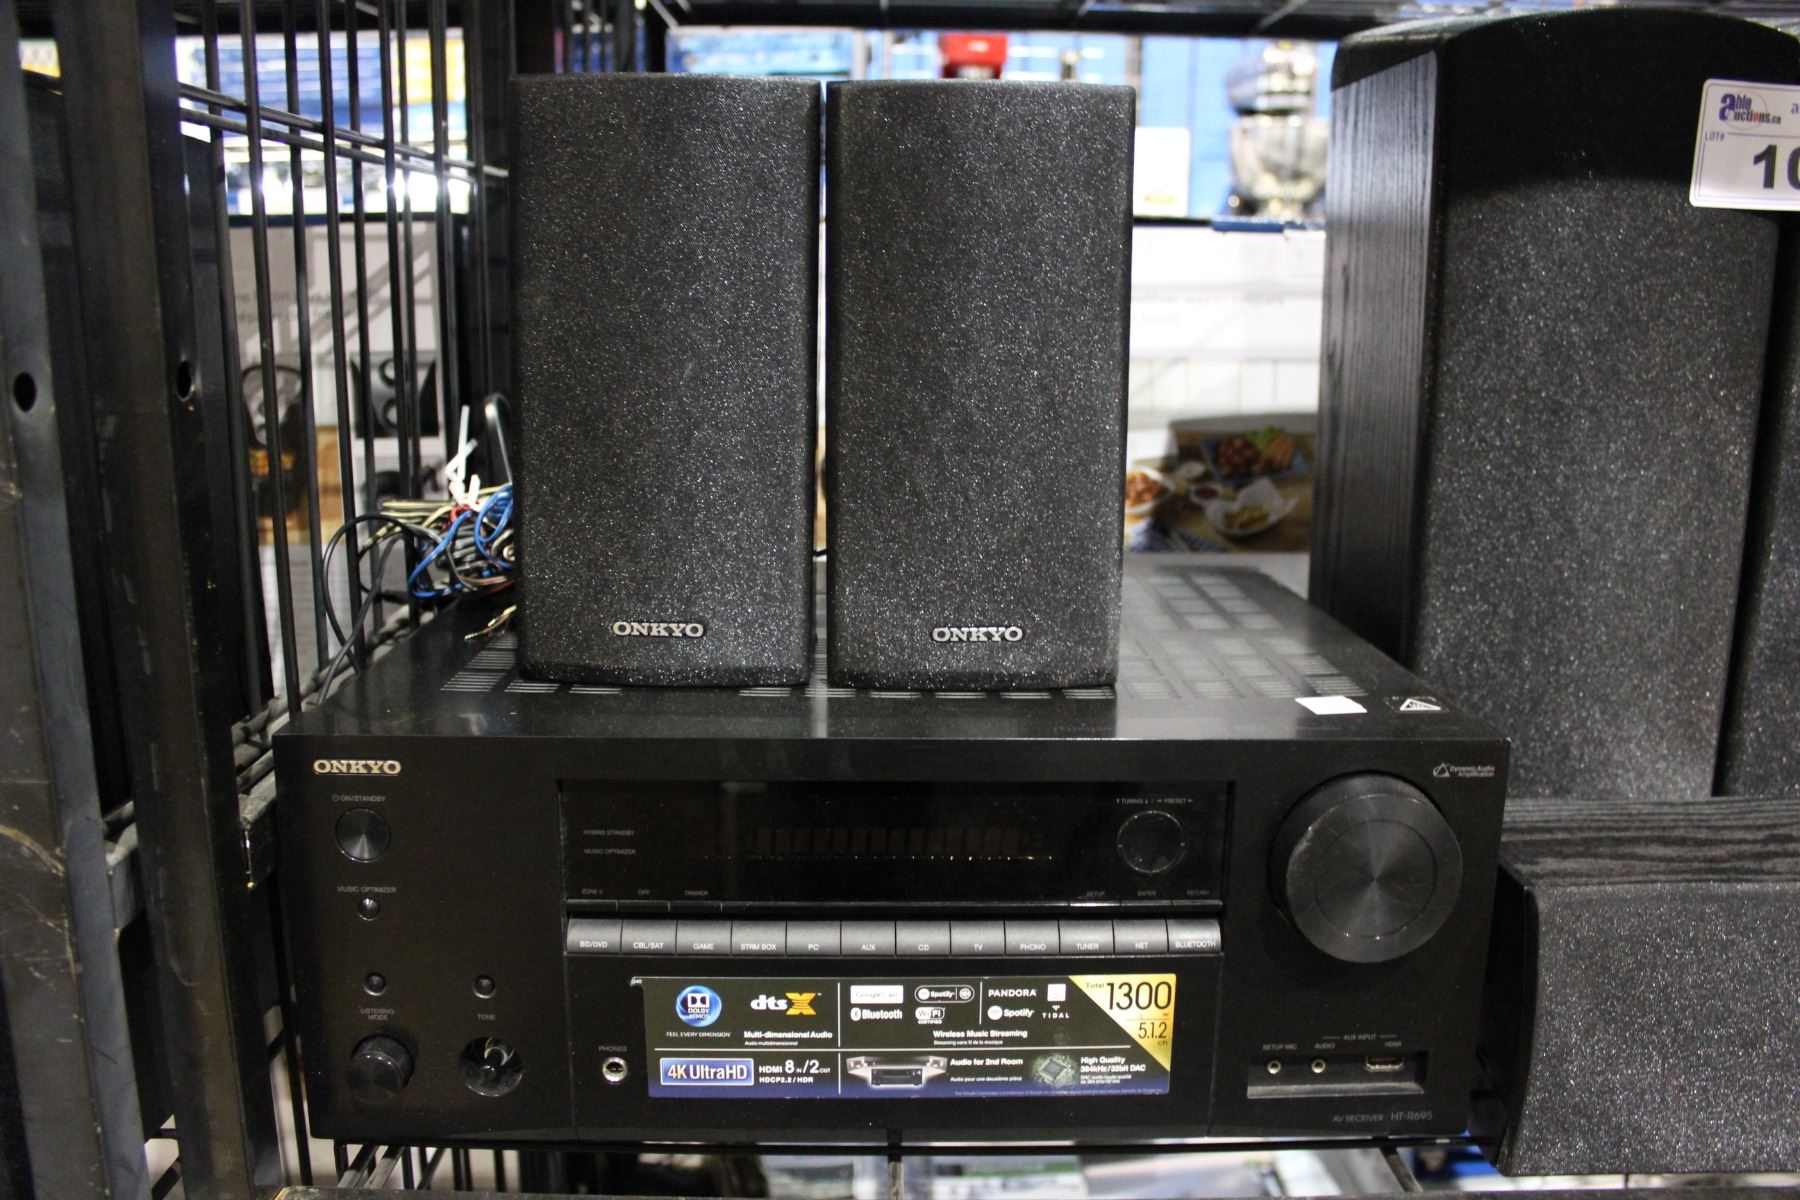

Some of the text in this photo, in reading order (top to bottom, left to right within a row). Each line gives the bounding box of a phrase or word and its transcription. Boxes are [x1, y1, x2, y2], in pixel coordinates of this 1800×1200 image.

[612, 621, 704, 637] ONKYO
[932, 626, 1023, 642] ONKYO
[313, 759, 401, 775] ONKYO
[579, 941, 608, 949] BD/DVD
[633, 942, 664, 950] CBL/SAT
[692, 943, 714, 951] GAME
[740, 943, 777, 951] STRM BOX
[808, 943, 819, 951] PC
[861, 943, 876, 951] AUX
[918, 943, 930, 951] CD
[973, 943, 984, 951] TV
[1019, 943, 1047, 951] PHONO
[1076, 943, 1099, 951] TUNER
[1135, 941, 1149, 949] NET
[1174, 939, 1217, 948] BLUETOOTH
[930, 990, 954, 999] Spotify
[988, 988, 1036, 998] PANDORA
[1106, 981, 1172, 1010] 1300
[477, 1013, 496, 1021] TONE
[861, 1009, 903, 1020] Bluetooth
[1003, 1008, 1034, 1018] Spotify
[744, 1030, 833, 1039] Multi-dimensional Audio
[933, 1030, 1028, 1039] Wireless Music Streaming
[1138, 1021, 1167, 1039] 5.1.2
[950, 1058, 972, 1066] Audio
[973, 1058, 984, 1066] for
[985, 1058, 999, 1066] 2nd
[1080, 1056, 1126, 1065] High Quality
[758, 1065, 783, 1074] HDMI
[784, 1059, 795, 1074] 8
[1130, 1064, 1147, 1072] DAC
[667, 1064, 747, 1080] 4K UltraHD
[1332, 1114, 1384, 1122] AV RECEIVER
[1390, 1111, 1433, 1121] HT-R695
